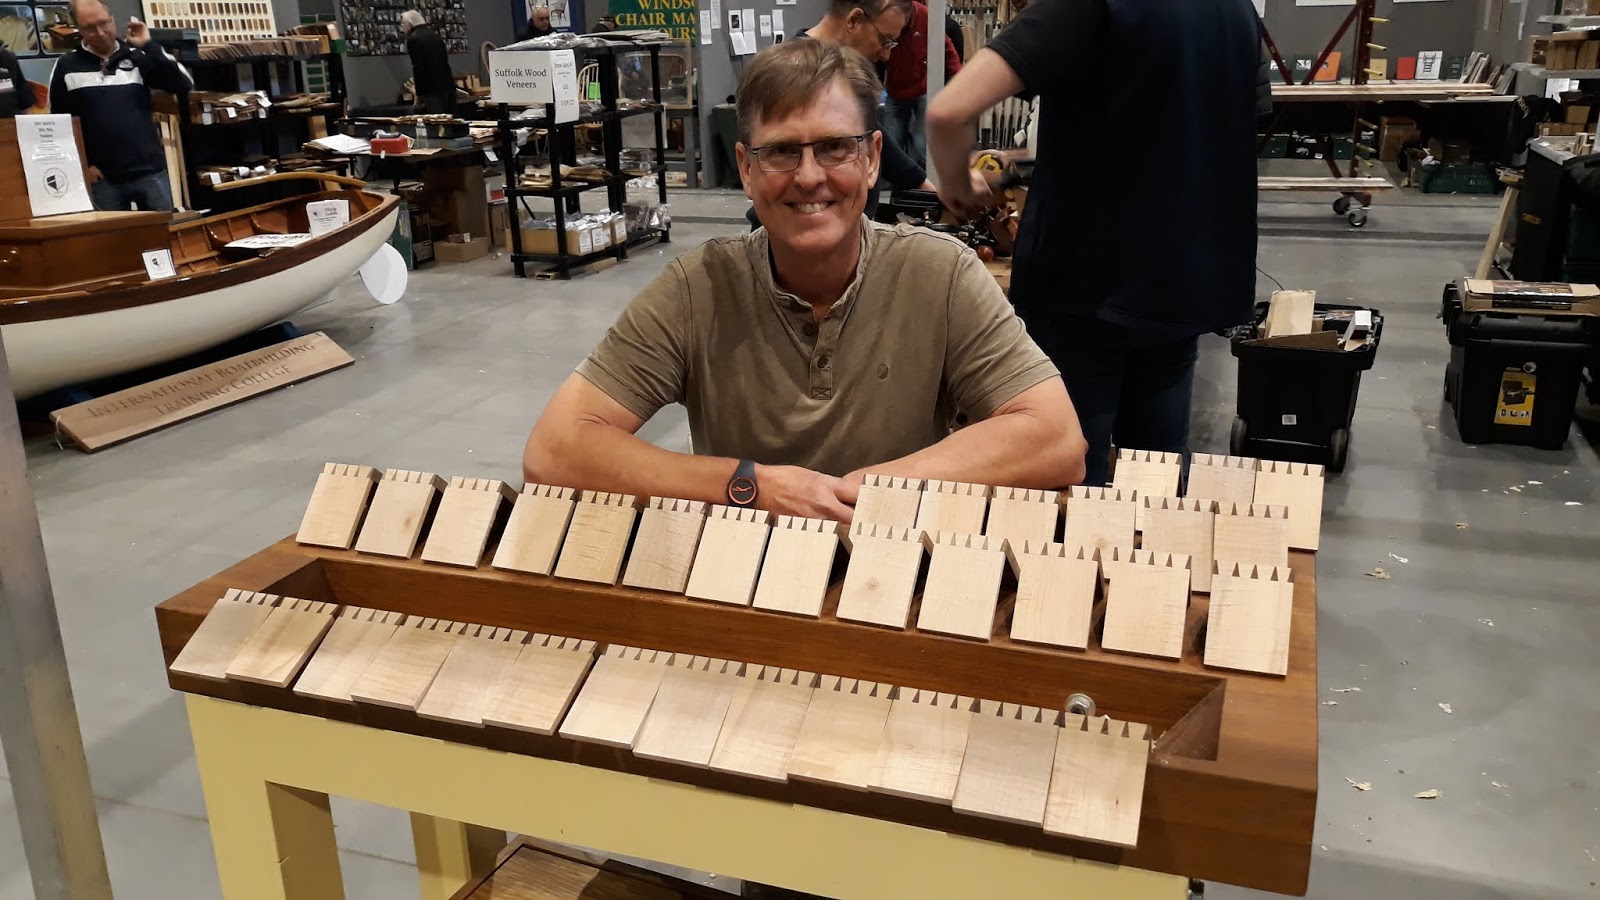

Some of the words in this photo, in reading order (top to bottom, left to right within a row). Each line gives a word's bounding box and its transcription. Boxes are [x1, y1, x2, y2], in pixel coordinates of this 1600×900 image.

[615, 12, 666, 26] CHAIR
[494, 68, 523, 77] Suffolk
[524, 68, 547, 77] Wood
[506, 80, 537, 89] Veneers
[87, 374, 213, 417] INTERNATIONAL
[214, 343, 316, 378] BOATBUILDING
[153, 386, 231, 415] TRAINING
[229, 364, 291, 390] COLLEGE
